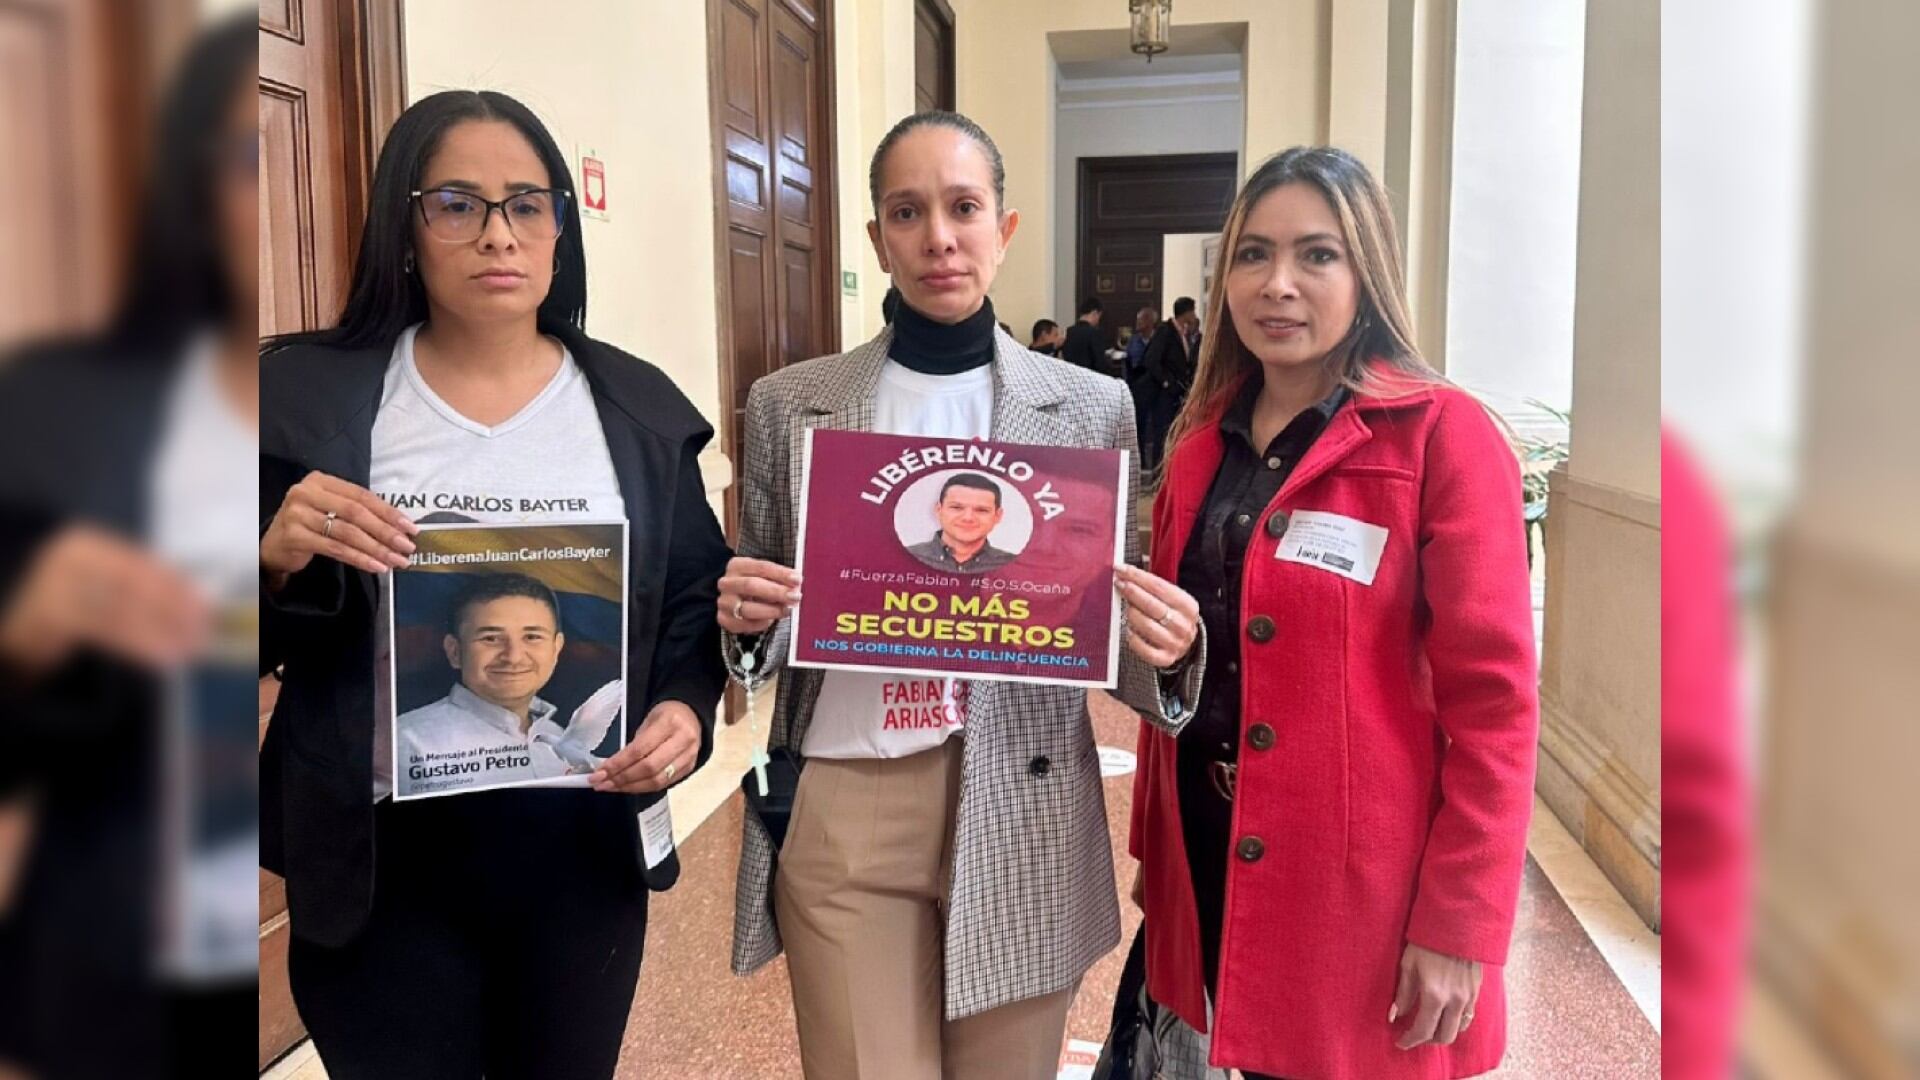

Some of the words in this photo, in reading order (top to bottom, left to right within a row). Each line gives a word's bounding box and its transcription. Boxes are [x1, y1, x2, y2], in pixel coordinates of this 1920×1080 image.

[860, 443, 1034, 504] LIBÉRENLO
[1033, 481, 1065, 521] YA
[376, 492, 426, 508] UAN
[433, 493, 513, 512] CARLOS
[519, 498, 590, 512] BAYTER
[409, 546, 611, 565] #LiberenaJuanCarlosBayter
[839, 569, 960, 587] #FuerzaFabian
[970, 577, 1071, 596] #S.O.S.Ocaña
[883, 591, 938, 612] NO
[949, 594, 1031, 620] MÁS
[836, 613, 1075, 648] SECUESTROS
[814, 639, 849, 652] NOS
[852, 641, 938, 658] GOBIERNA
[943, 647, 963, 659] LA
[967, 648, 1090, 668] DELINCUENCIA
[408, 762, 480, 780] Gustavo
[485, 755, 530, 771] Petro
[410, 753, 424, 764] Un
[426, 751, 467, 762] Mensaje
[469, 748, 477, 758] al
[479, 744, 529, 756] Presidente
